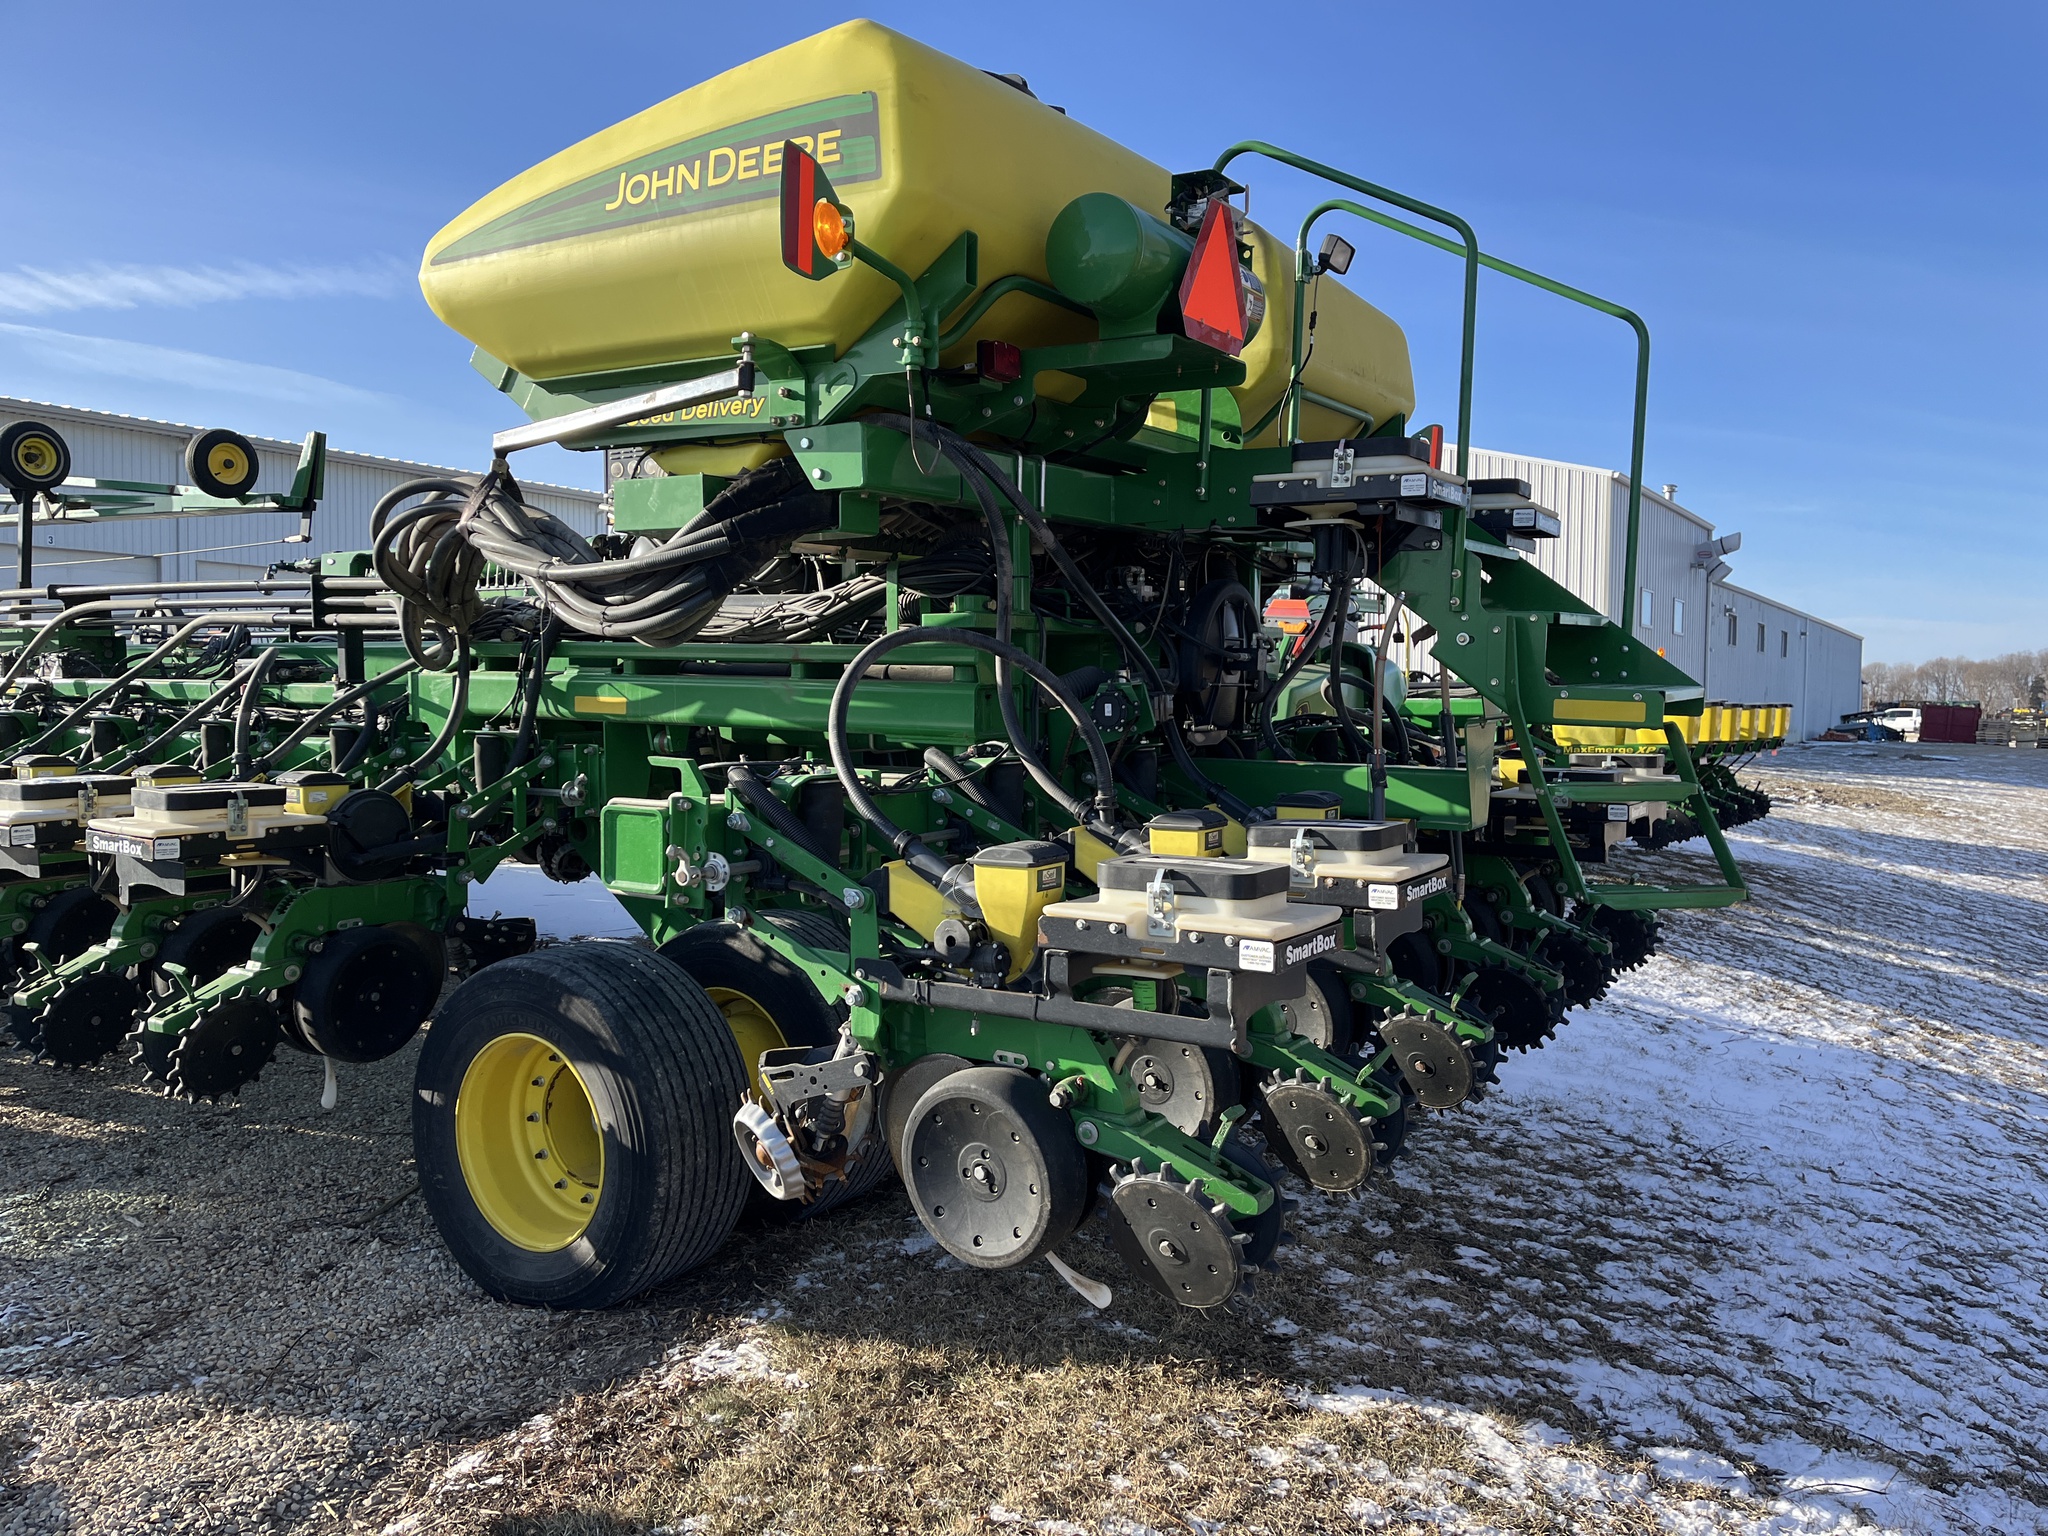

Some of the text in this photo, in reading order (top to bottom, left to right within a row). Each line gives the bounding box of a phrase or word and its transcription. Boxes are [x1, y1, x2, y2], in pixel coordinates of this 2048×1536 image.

[605, 159, 702, 212] JOHN
[681, 397, 765, 421] Delivery
[1432, 480, 1462, 502] SmartBox
[48, 535, 54, 544] 3
[1563, 746, 1657, 754] MaxEmerge XP
[92, 835, 143, 856] SmartBox
[1406, 876, 1447, 901] SmartBox
[1249, 945, 1271, 953] AMVAC
[1286, 934, 1337, 965] SmartBox
